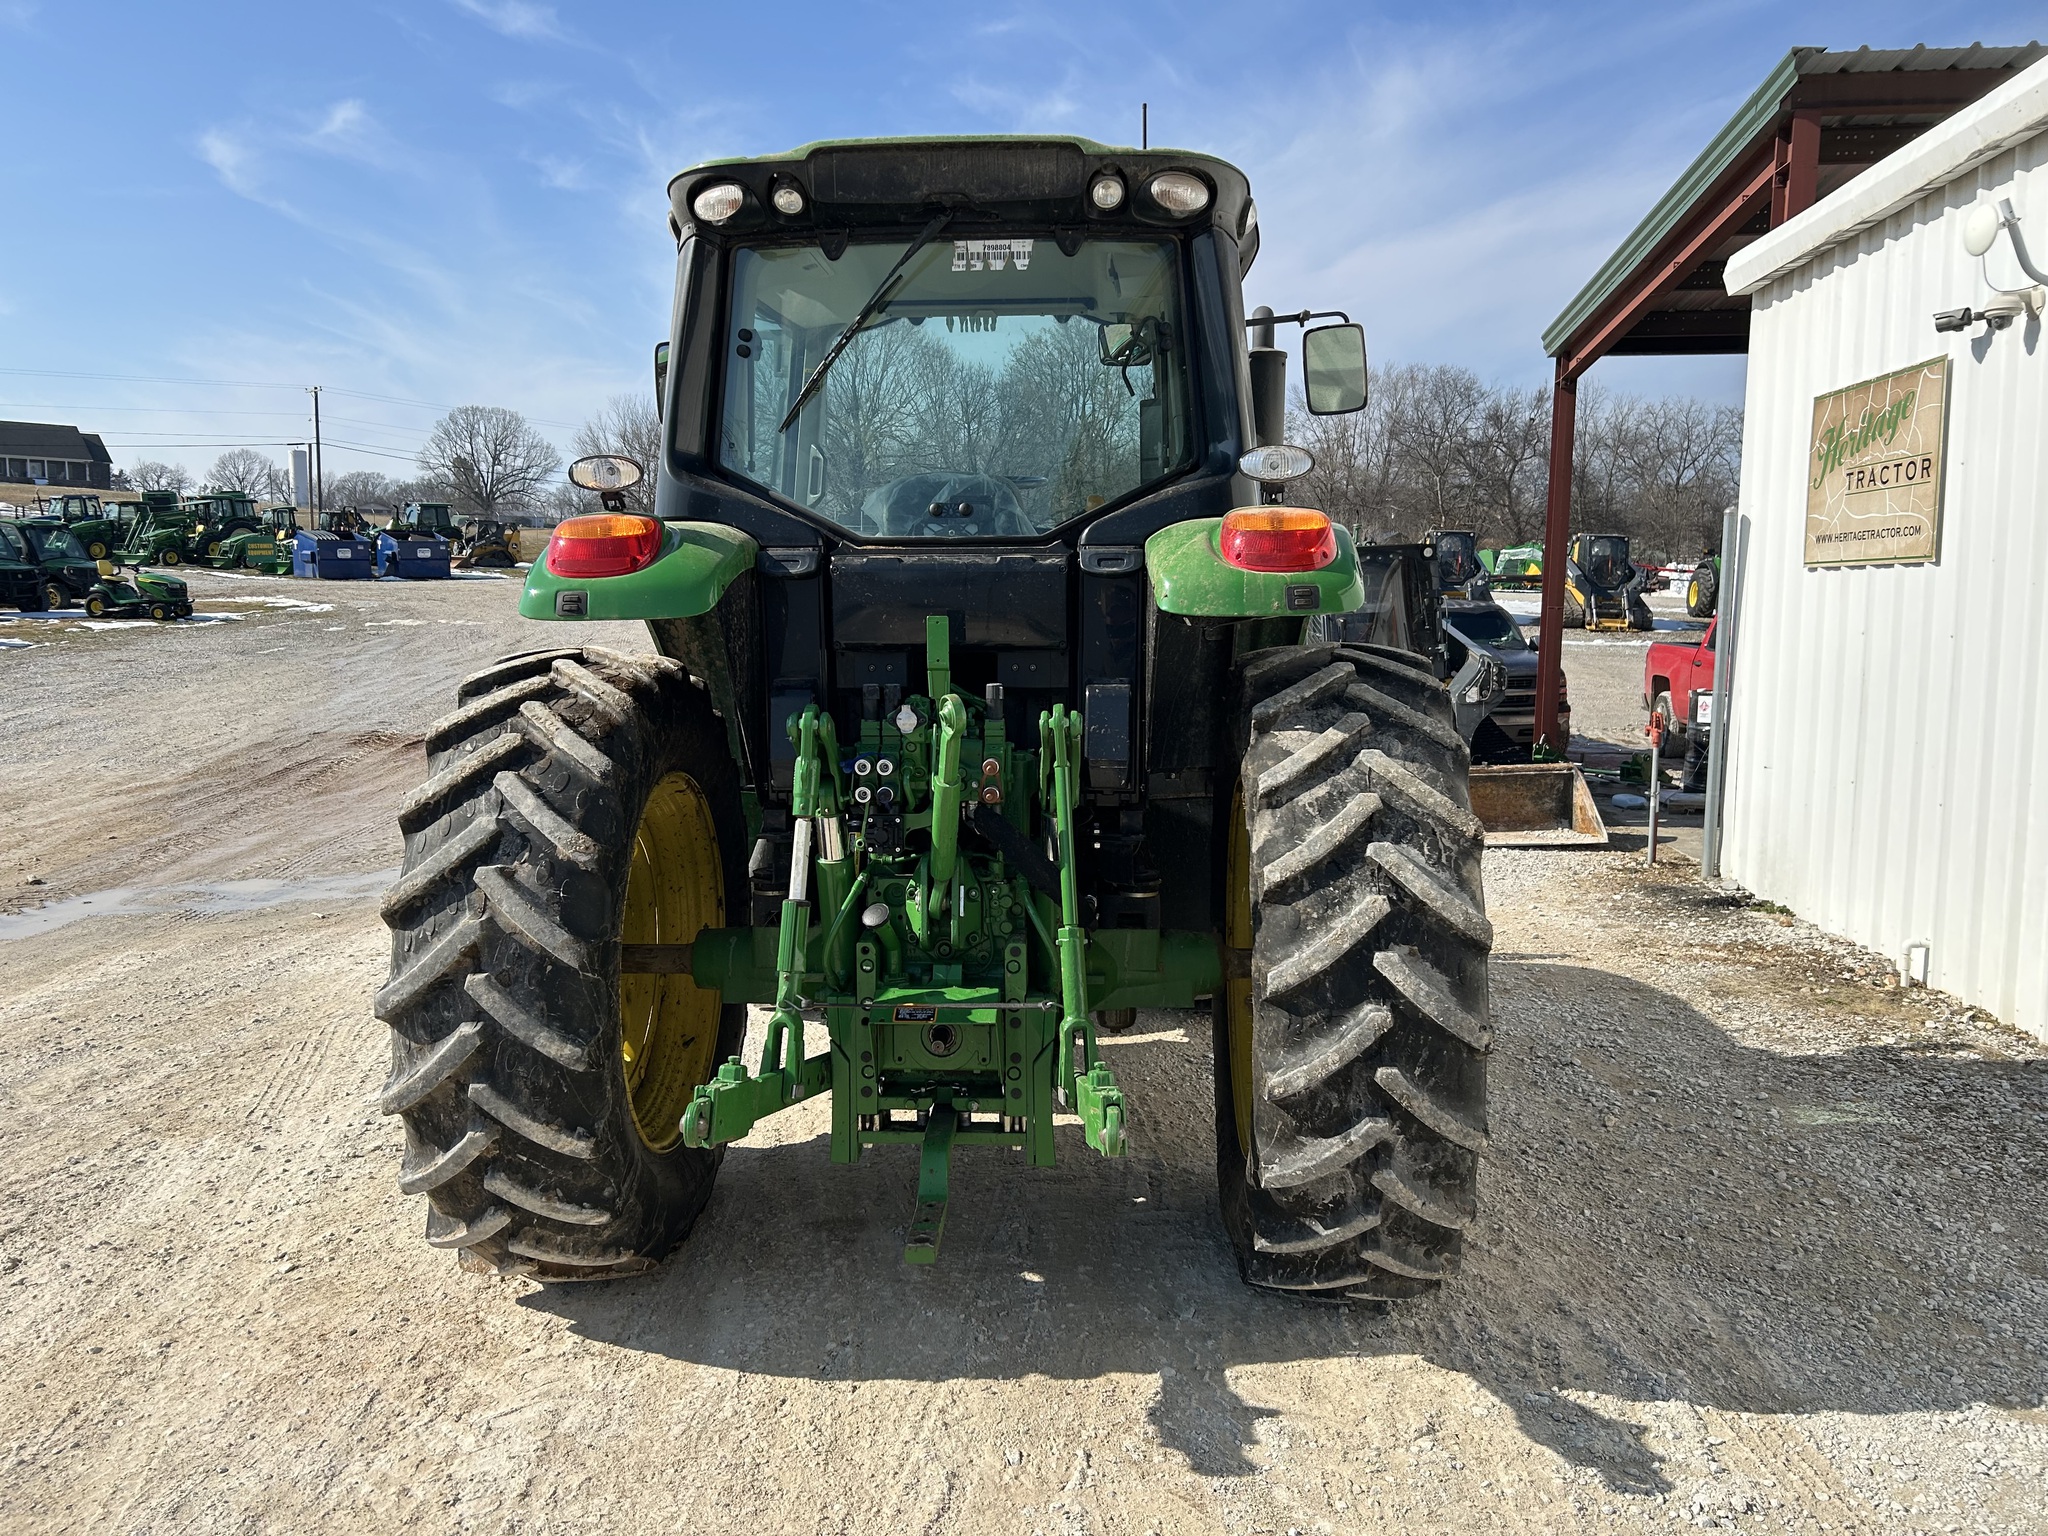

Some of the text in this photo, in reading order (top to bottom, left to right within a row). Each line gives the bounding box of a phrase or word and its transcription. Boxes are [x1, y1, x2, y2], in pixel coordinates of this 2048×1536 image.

[1813, 390, 1915, 489] Heritage
[1846, 457, 1932, 490] TRACTOR
[1815, 525, 1921, 544] WWW.HERITAGETRACTOR.COM
